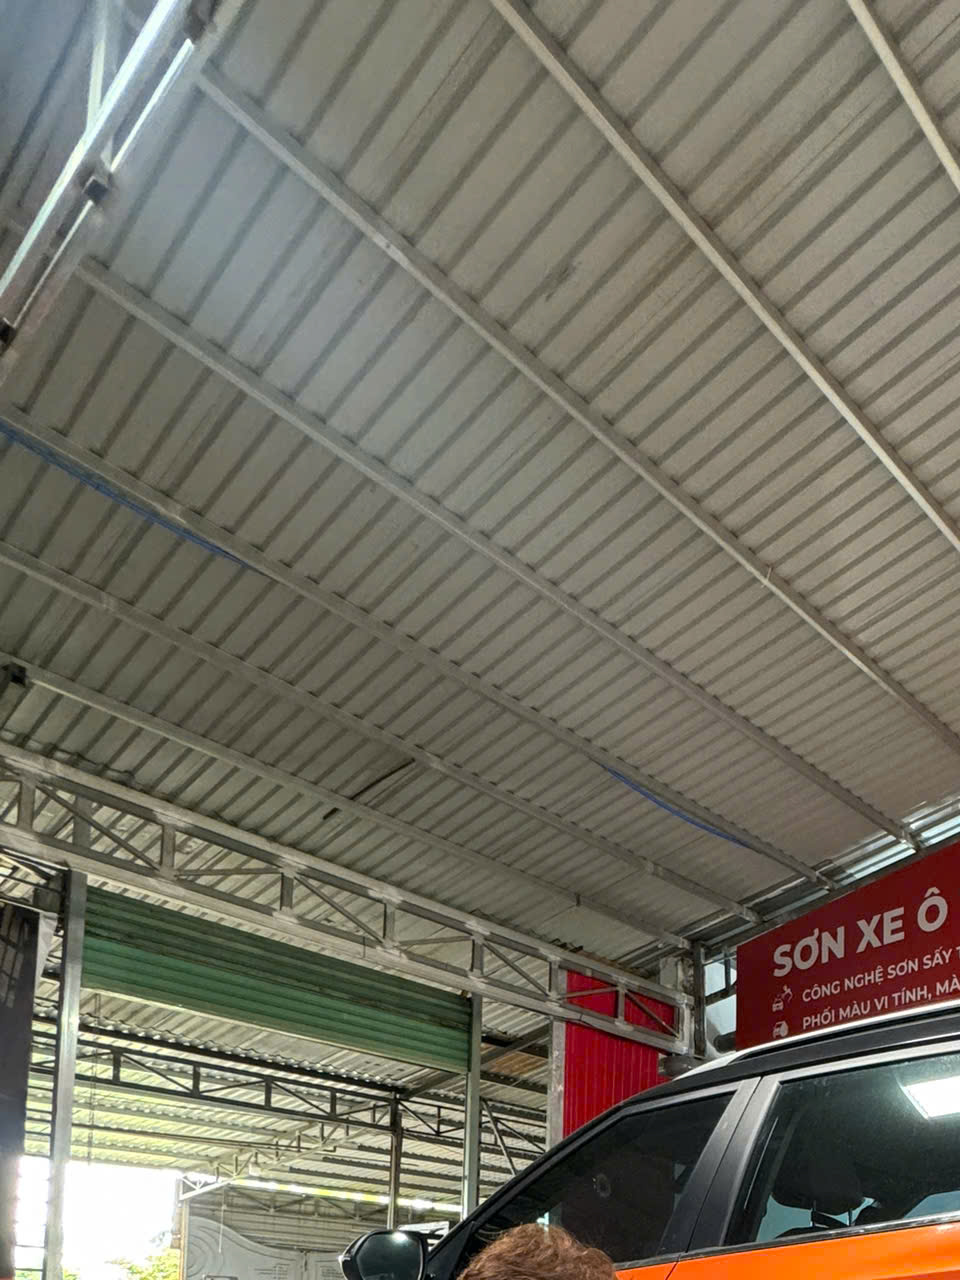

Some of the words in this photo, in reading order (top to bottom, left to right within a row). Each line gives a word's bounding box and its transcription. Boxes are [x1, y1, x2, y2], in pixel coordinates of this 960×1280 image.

[773, 926, 845, 977] SƠN
[856, 907, 905, 953] XE
[917, 887, 948, 932] Ô
[802, 981, 841, 1002] CÔNG
[844, 965, 884, 992] NGHỆ
[887, 957, 919, 979] SƠN
[922, 946, 953, 969] SẤY
[802, 1006, 835, 1030] PHỐI
[839, 1001, 871, 1020] MÀU
[874, 995, 889, 1011] VI
[892, 984, 932, 1006] TÍNH,
